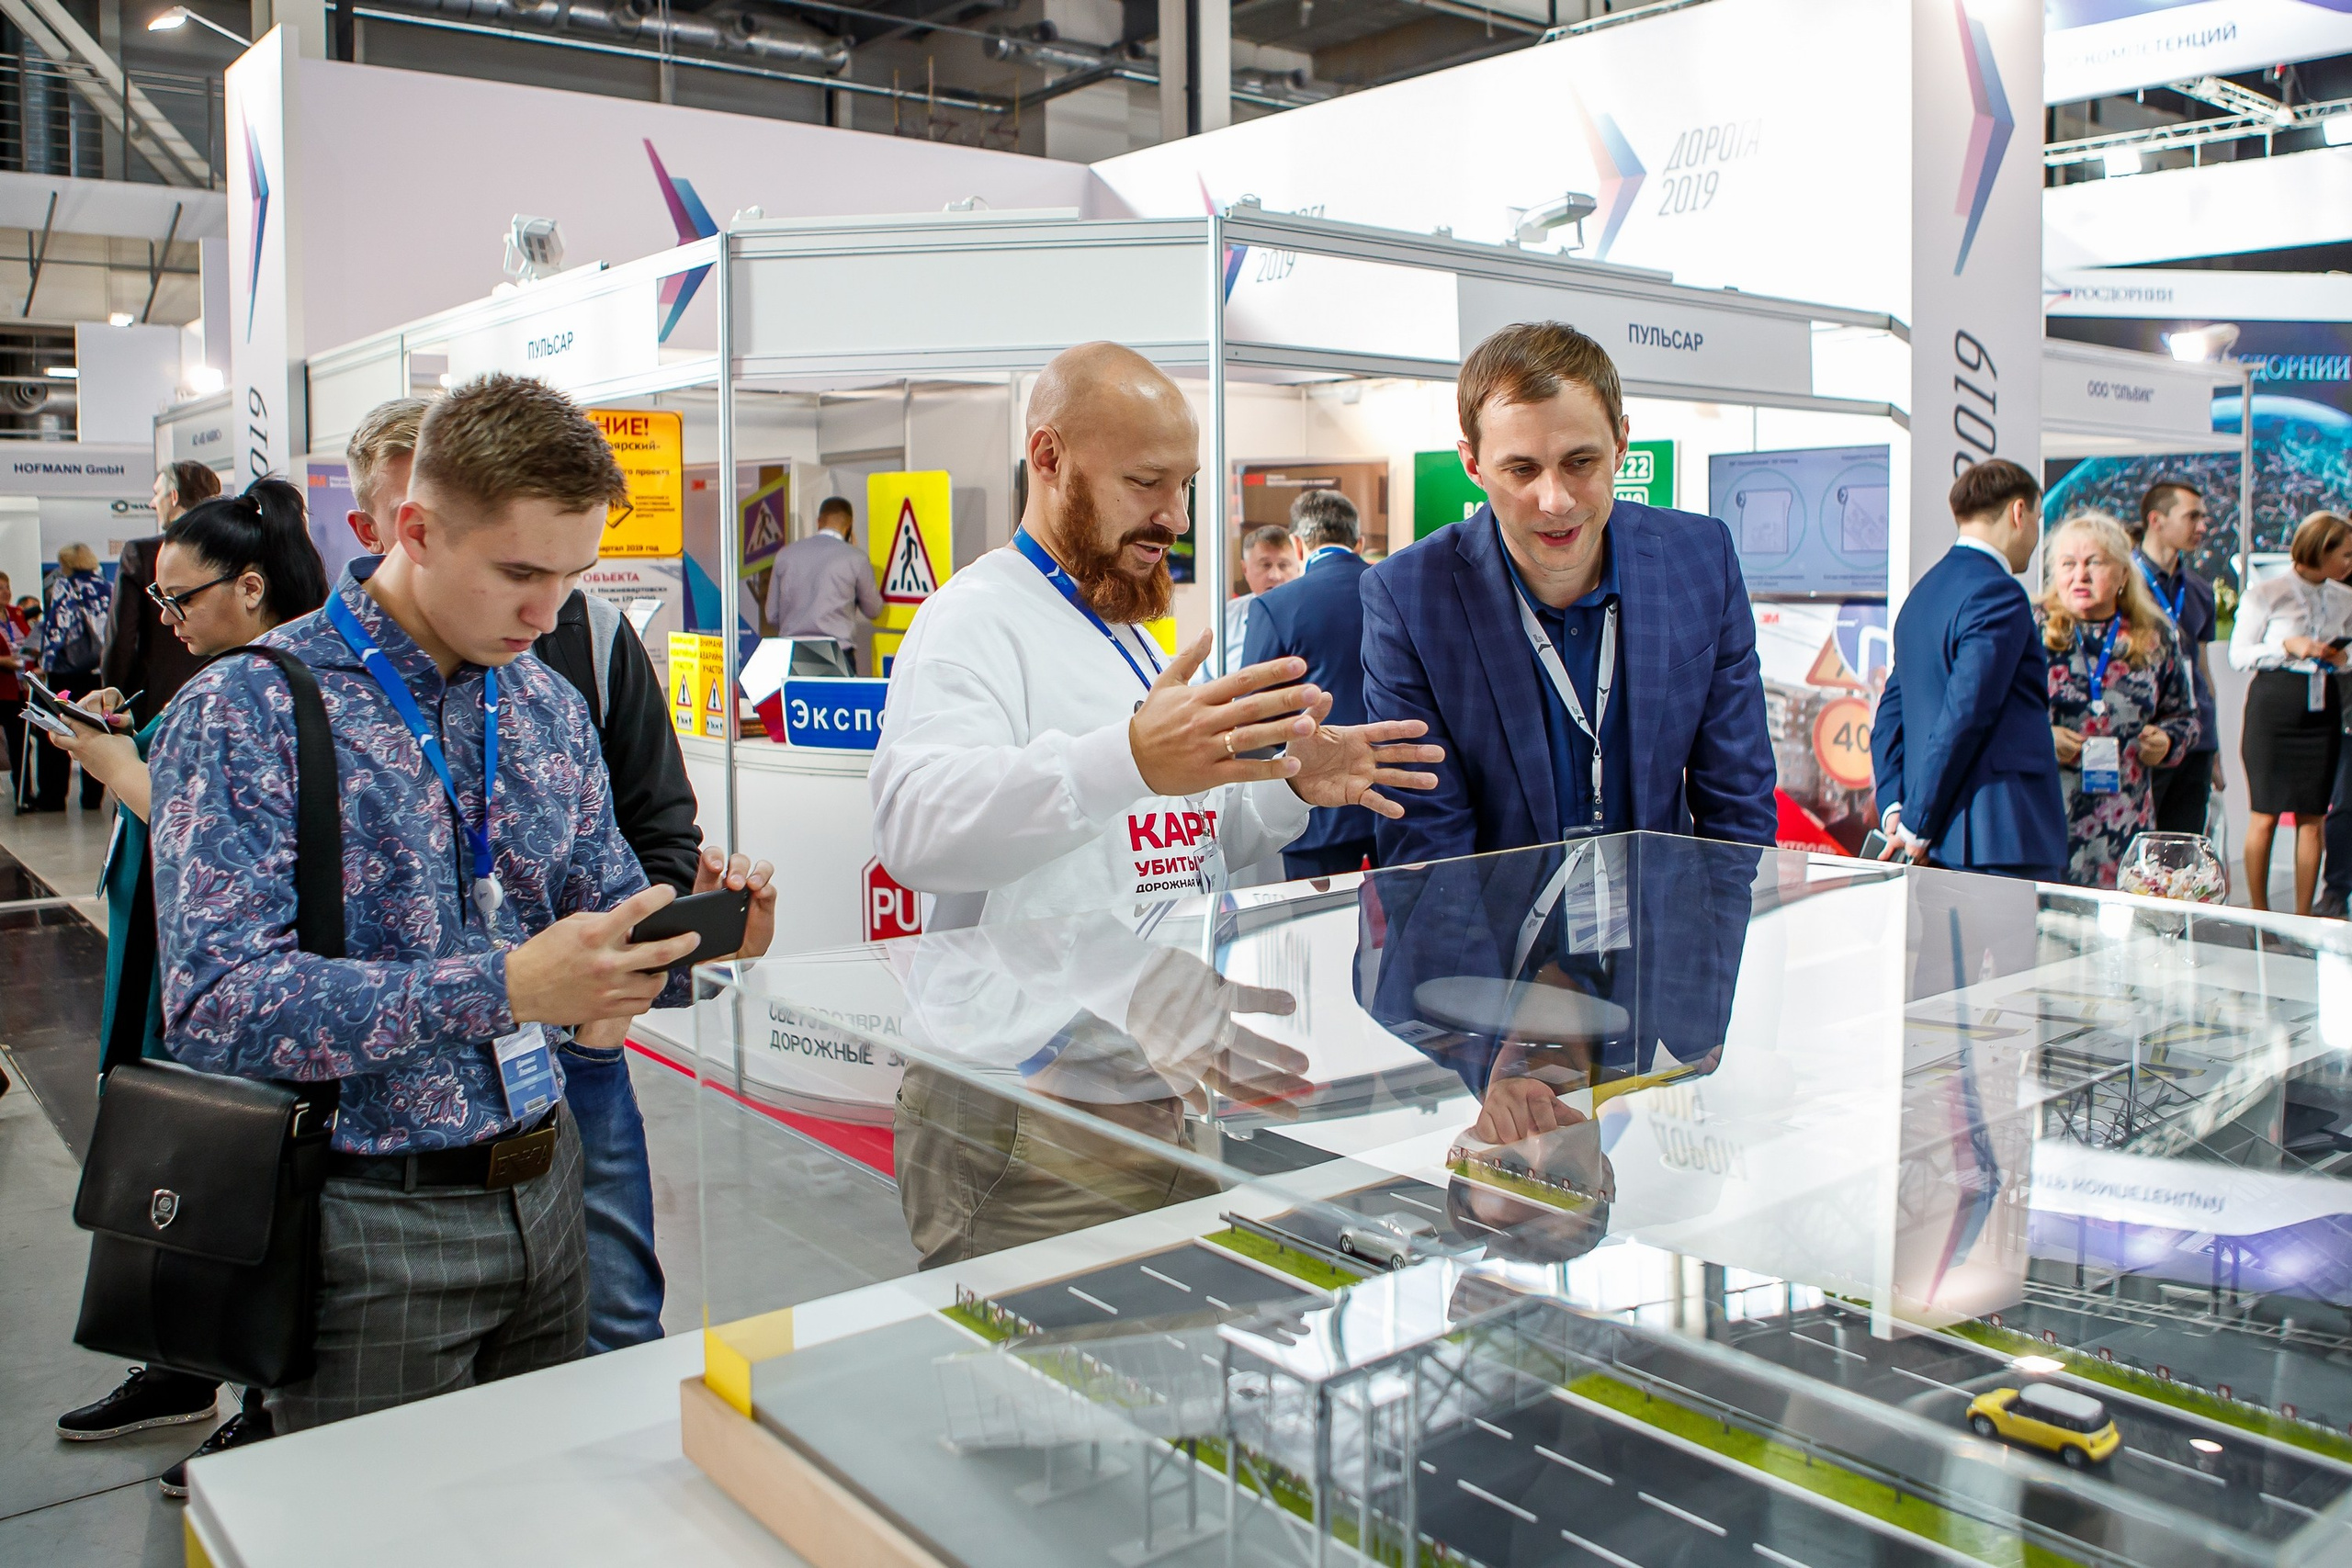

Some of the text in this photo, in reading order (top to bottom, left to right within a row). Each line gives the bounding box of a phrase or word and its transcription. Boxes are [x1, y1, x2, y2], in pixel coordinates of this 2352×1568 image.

[1662, 117, 1763, 175] ДОРОГА
[1657, 170, 1720, 217] 2019
[527, 331, 574, 360] ПУЛЬСАР
[1629, 322, 1704, 352] ПУЛЬСАР
[14, 463, 125, 475] HOFMANN GmbH
[582, 573, 639, 583] ОБЪЕКТА
[1833, 721, 1871, 752] 40
[1136, 880, 1196, 893] ДОРОЖНАЯ
[872, 887, 921, 931] PU
[770, 1030, 875, 1066] ДОРОЖНЫЕ
